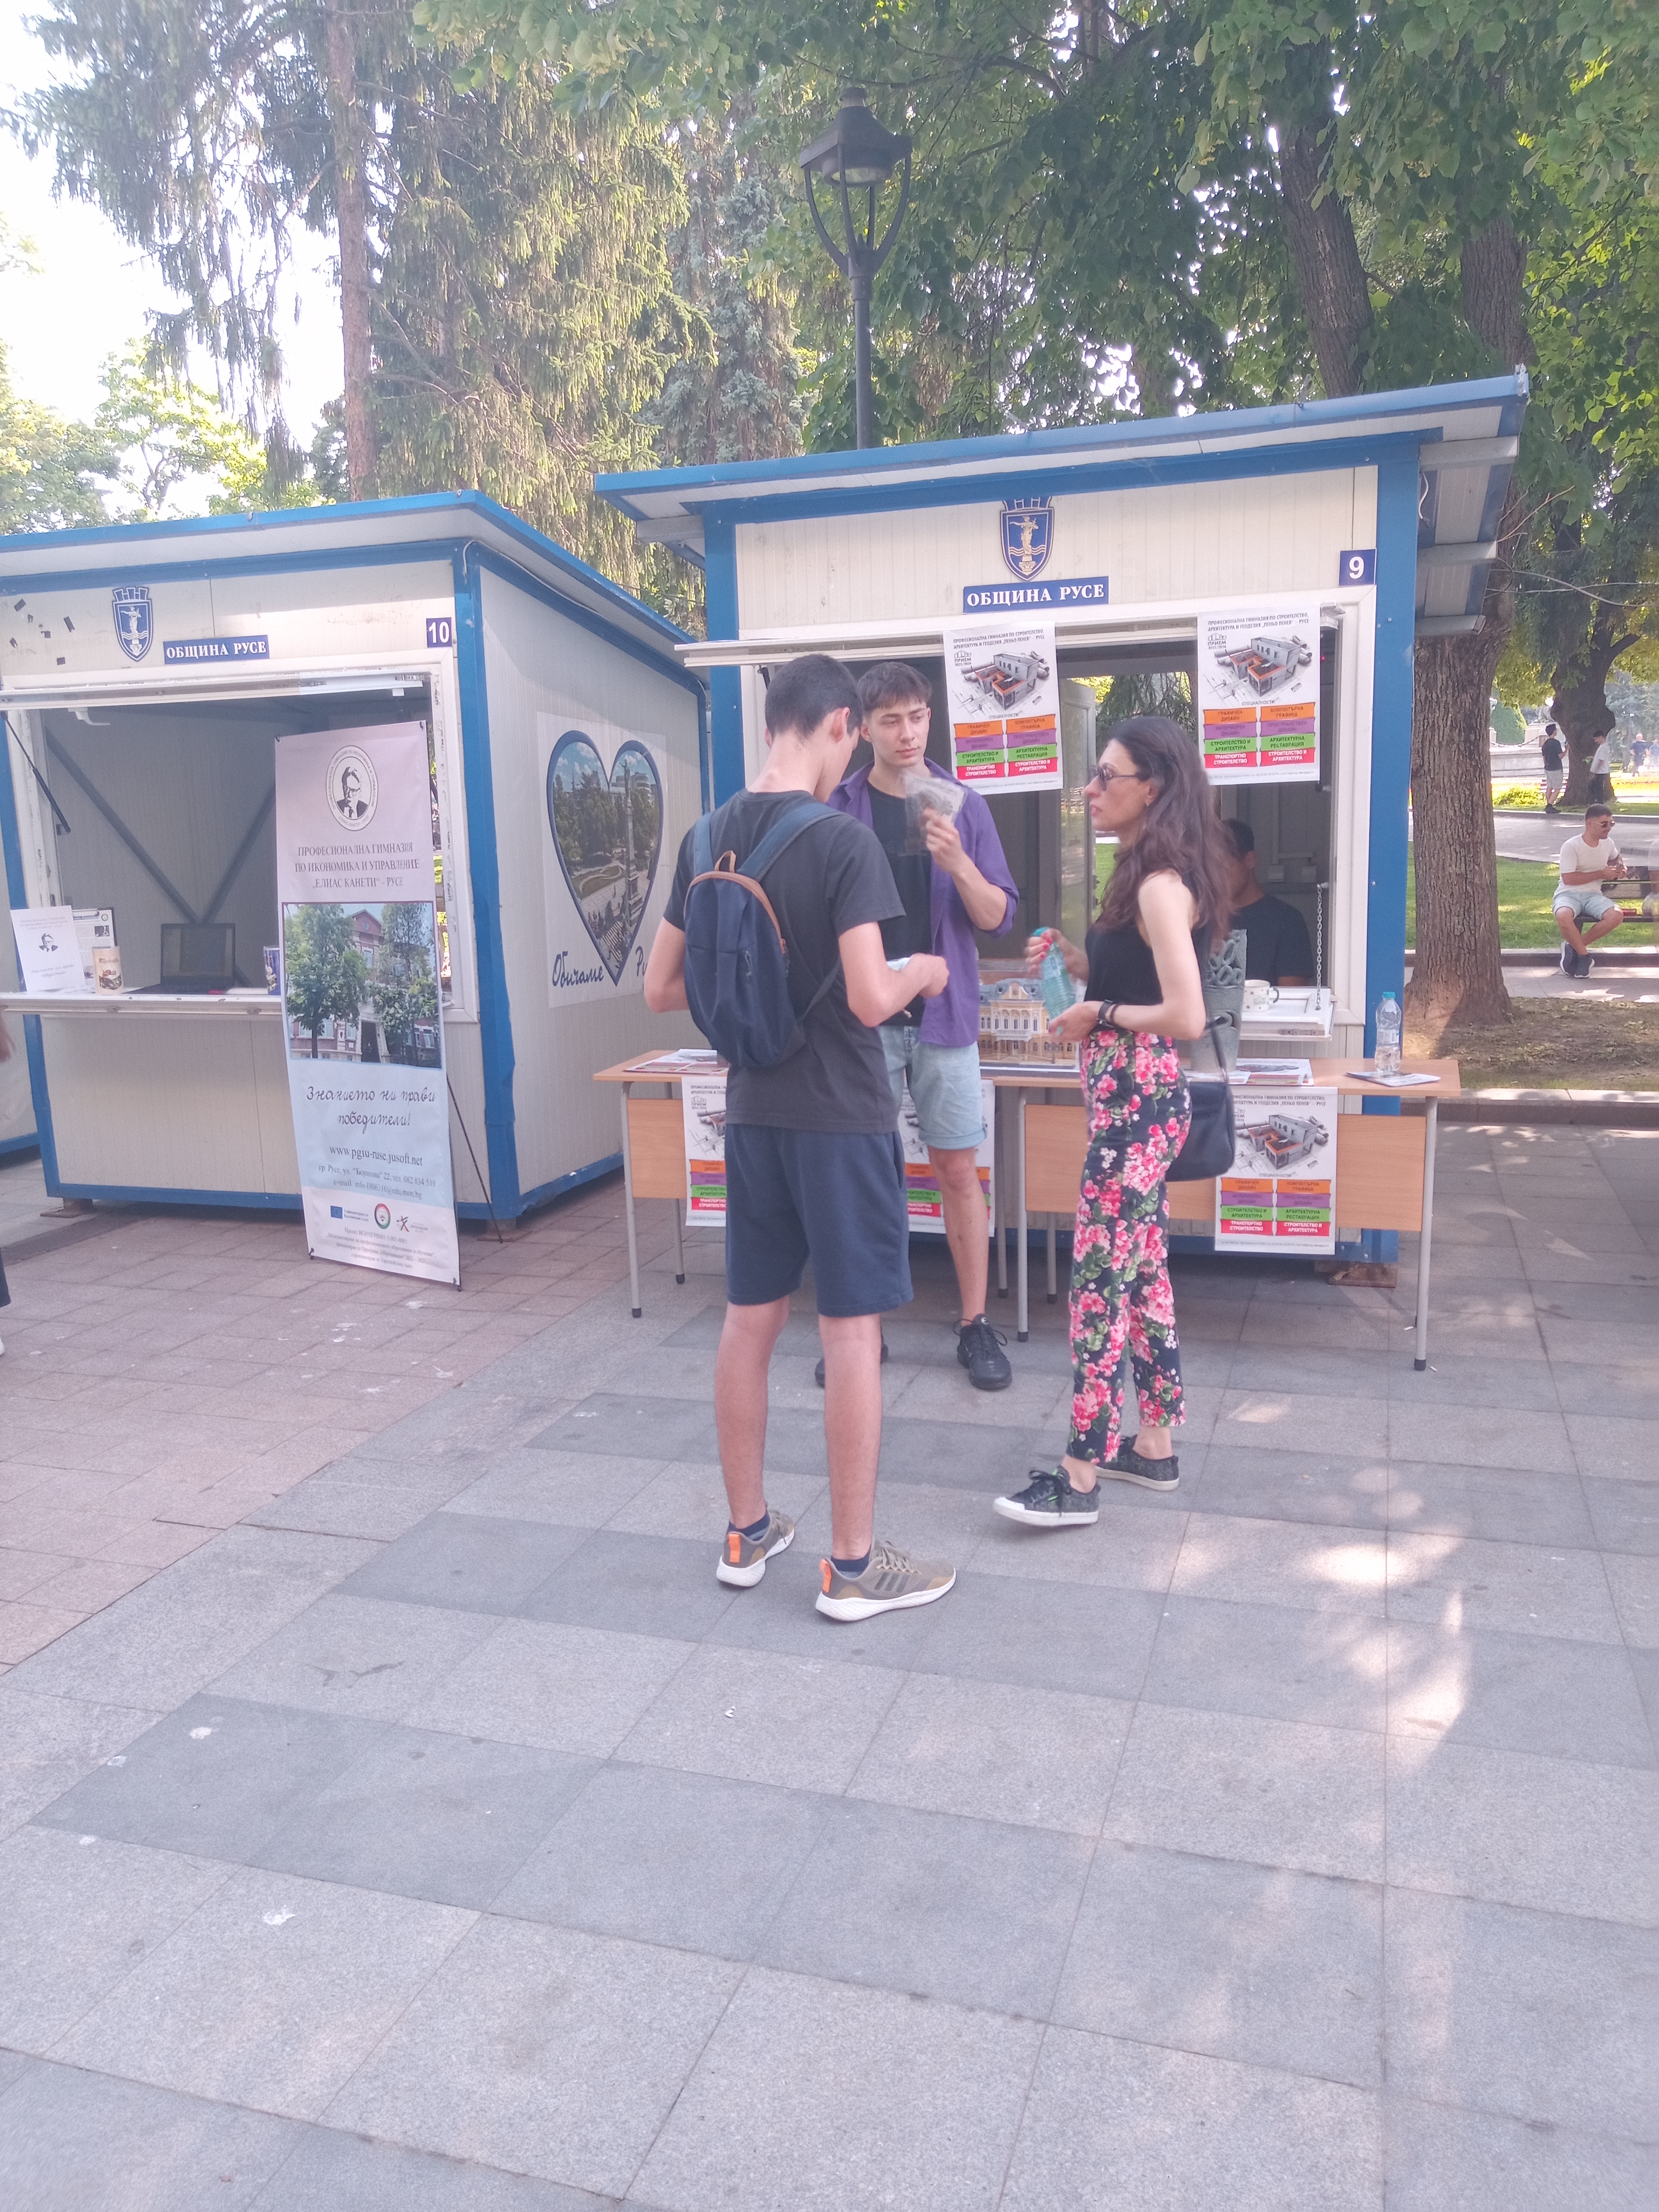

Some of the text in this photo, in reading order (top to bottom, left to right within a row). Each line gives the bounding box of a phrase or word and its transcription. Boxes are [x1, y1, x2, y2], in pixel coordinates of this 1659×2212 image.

[1348, 556, 1365, 579] 9
[967, 584, 1105, 607] ОБЩИНА РУСЕ
[428, 622, 449, 644] 10
[166, 641, 267, 660] ОБЩИНА РУСЕ
[298, 842, 413, 856] ПРОФЕСИОНАЛНА ГИМНАЗИЯ
[295, 859, 420, 872] ПО ИКОНОМИКА И УПРАВЛЕНИЕ
[387, 877, 404, 887] РУСЕ
[552, 951, 604, 988] Обичаме
[306, 1086, 437, 1106] Знанието ни прави
[338, 1110, 410, 1134] победители!
[404, 1176, 413, 1184] 082
